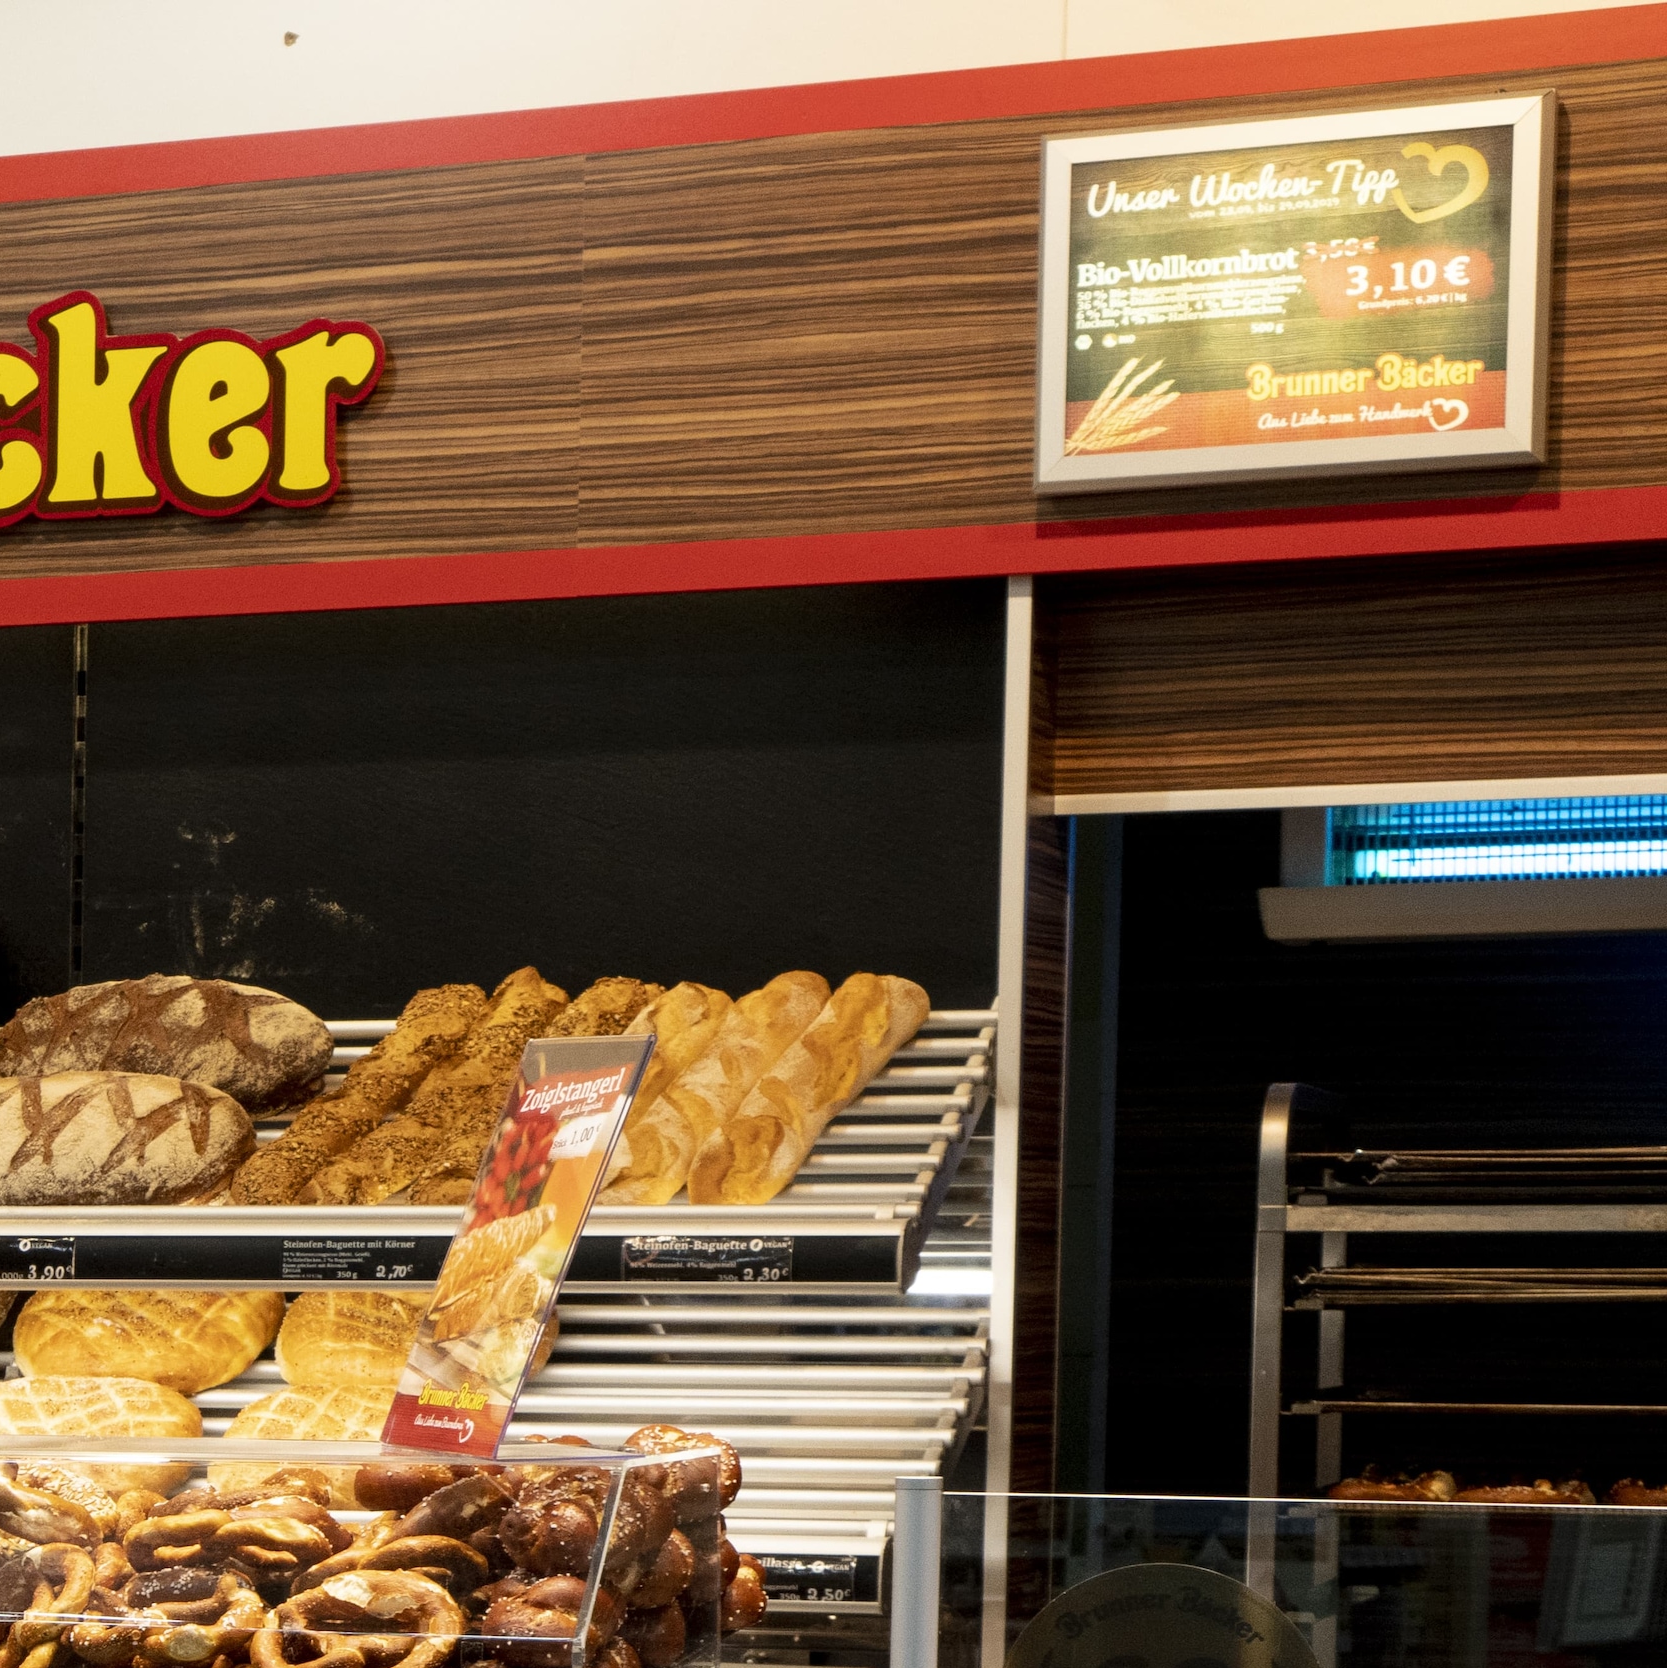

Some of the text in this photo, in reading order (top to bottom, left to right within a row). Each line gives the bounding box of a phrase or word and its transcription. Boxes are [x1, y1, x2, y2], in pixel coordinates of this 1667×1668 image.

[1087, 179, 1179, 218] Unser
[1190, 159, 1399, 204] Wochen-Tipp
[1077, 247, 1299, 288] Bio-Vollkornbrot
[1346, 258, 1436, 298] 3,10
[1247, 352, 1484, 401] Brunner Bäcker
[520, 1068, 626, 1114] Zoiglstangerl
[571, 1126, 595, 1147] 1,00
[283, 1240, 365, 1250] Steinofen-Baguette
[418, 1379, 457, 1407] Brunner
